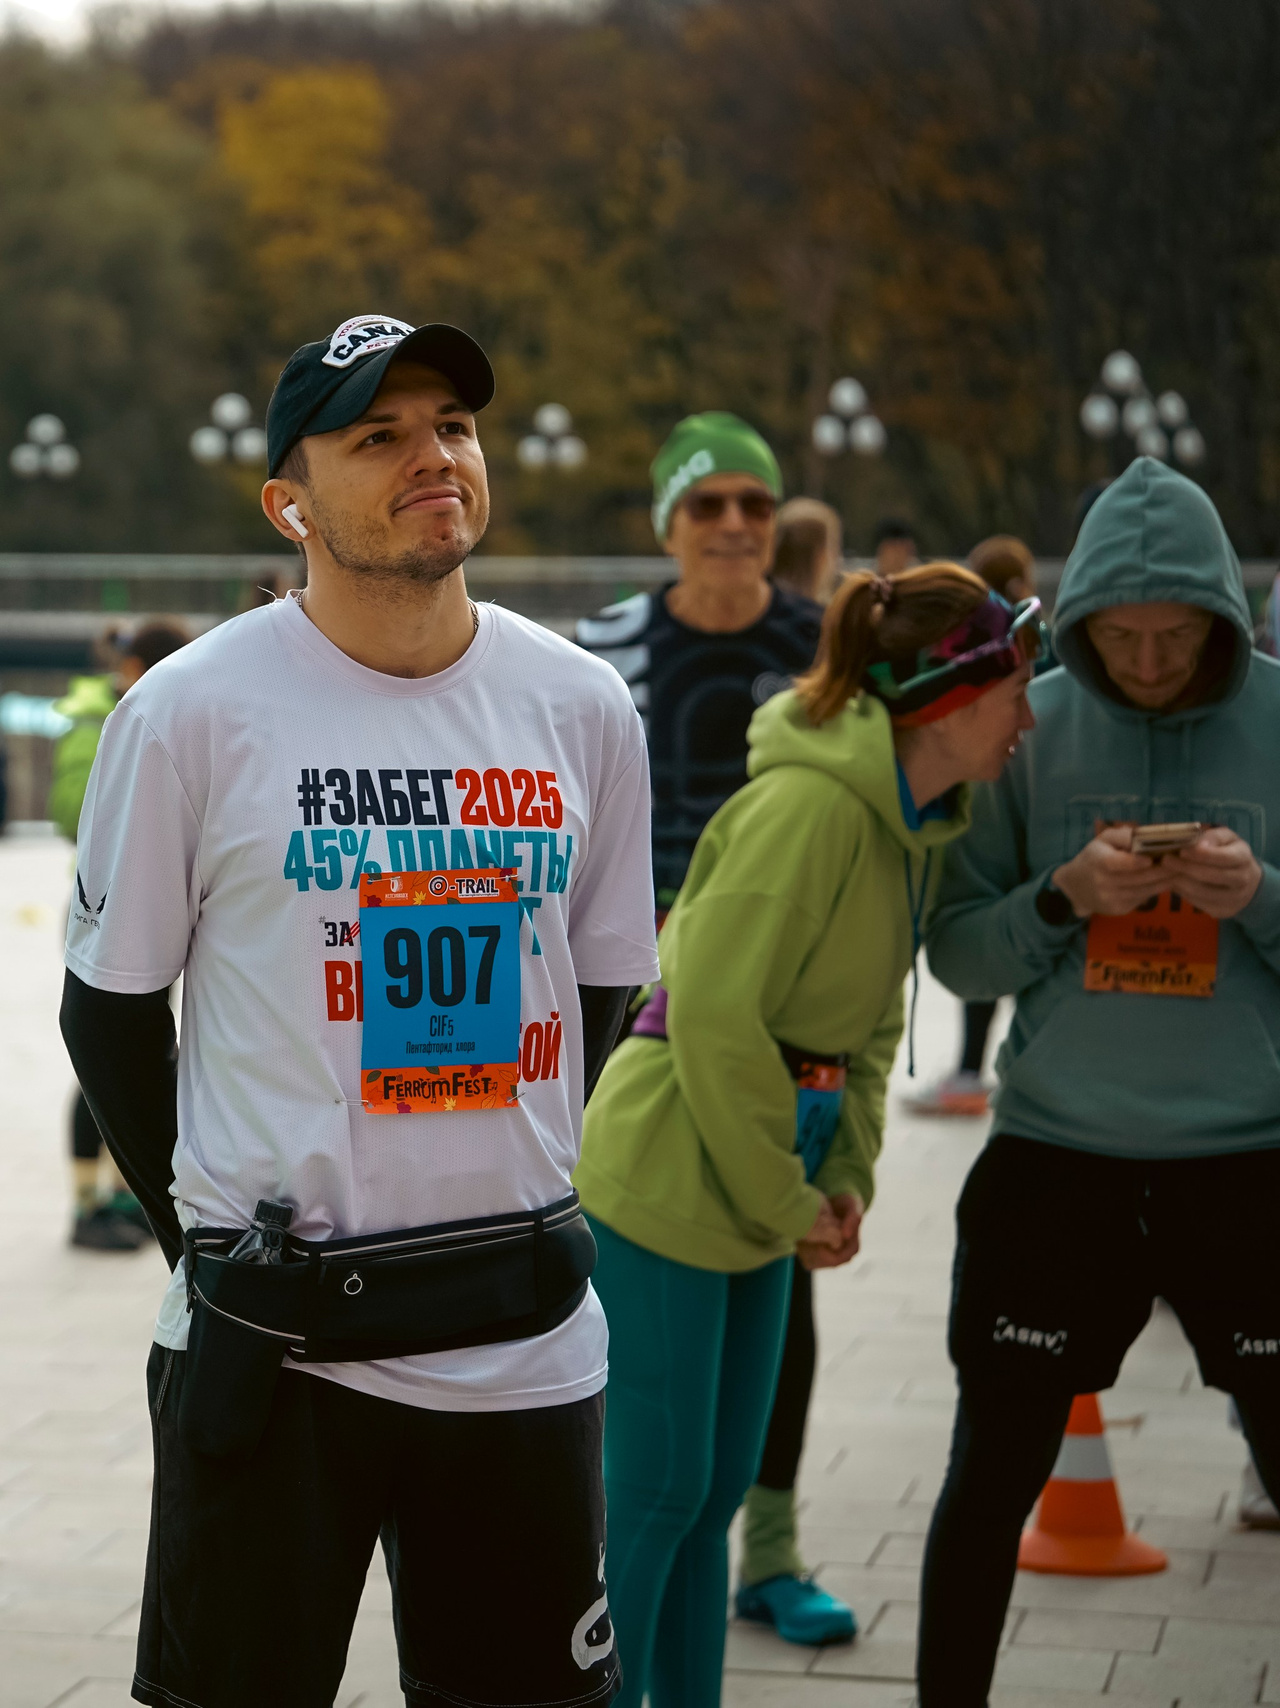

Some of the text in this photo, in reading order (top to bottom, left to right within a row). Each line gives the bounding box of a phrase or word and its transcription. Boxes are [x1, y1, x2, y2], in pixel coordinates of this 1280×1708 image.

[283, 829, 382, 892] 45%
[383, 925, 501, 1009] 907
[1240, 1336, 1280, 1356] ASR
